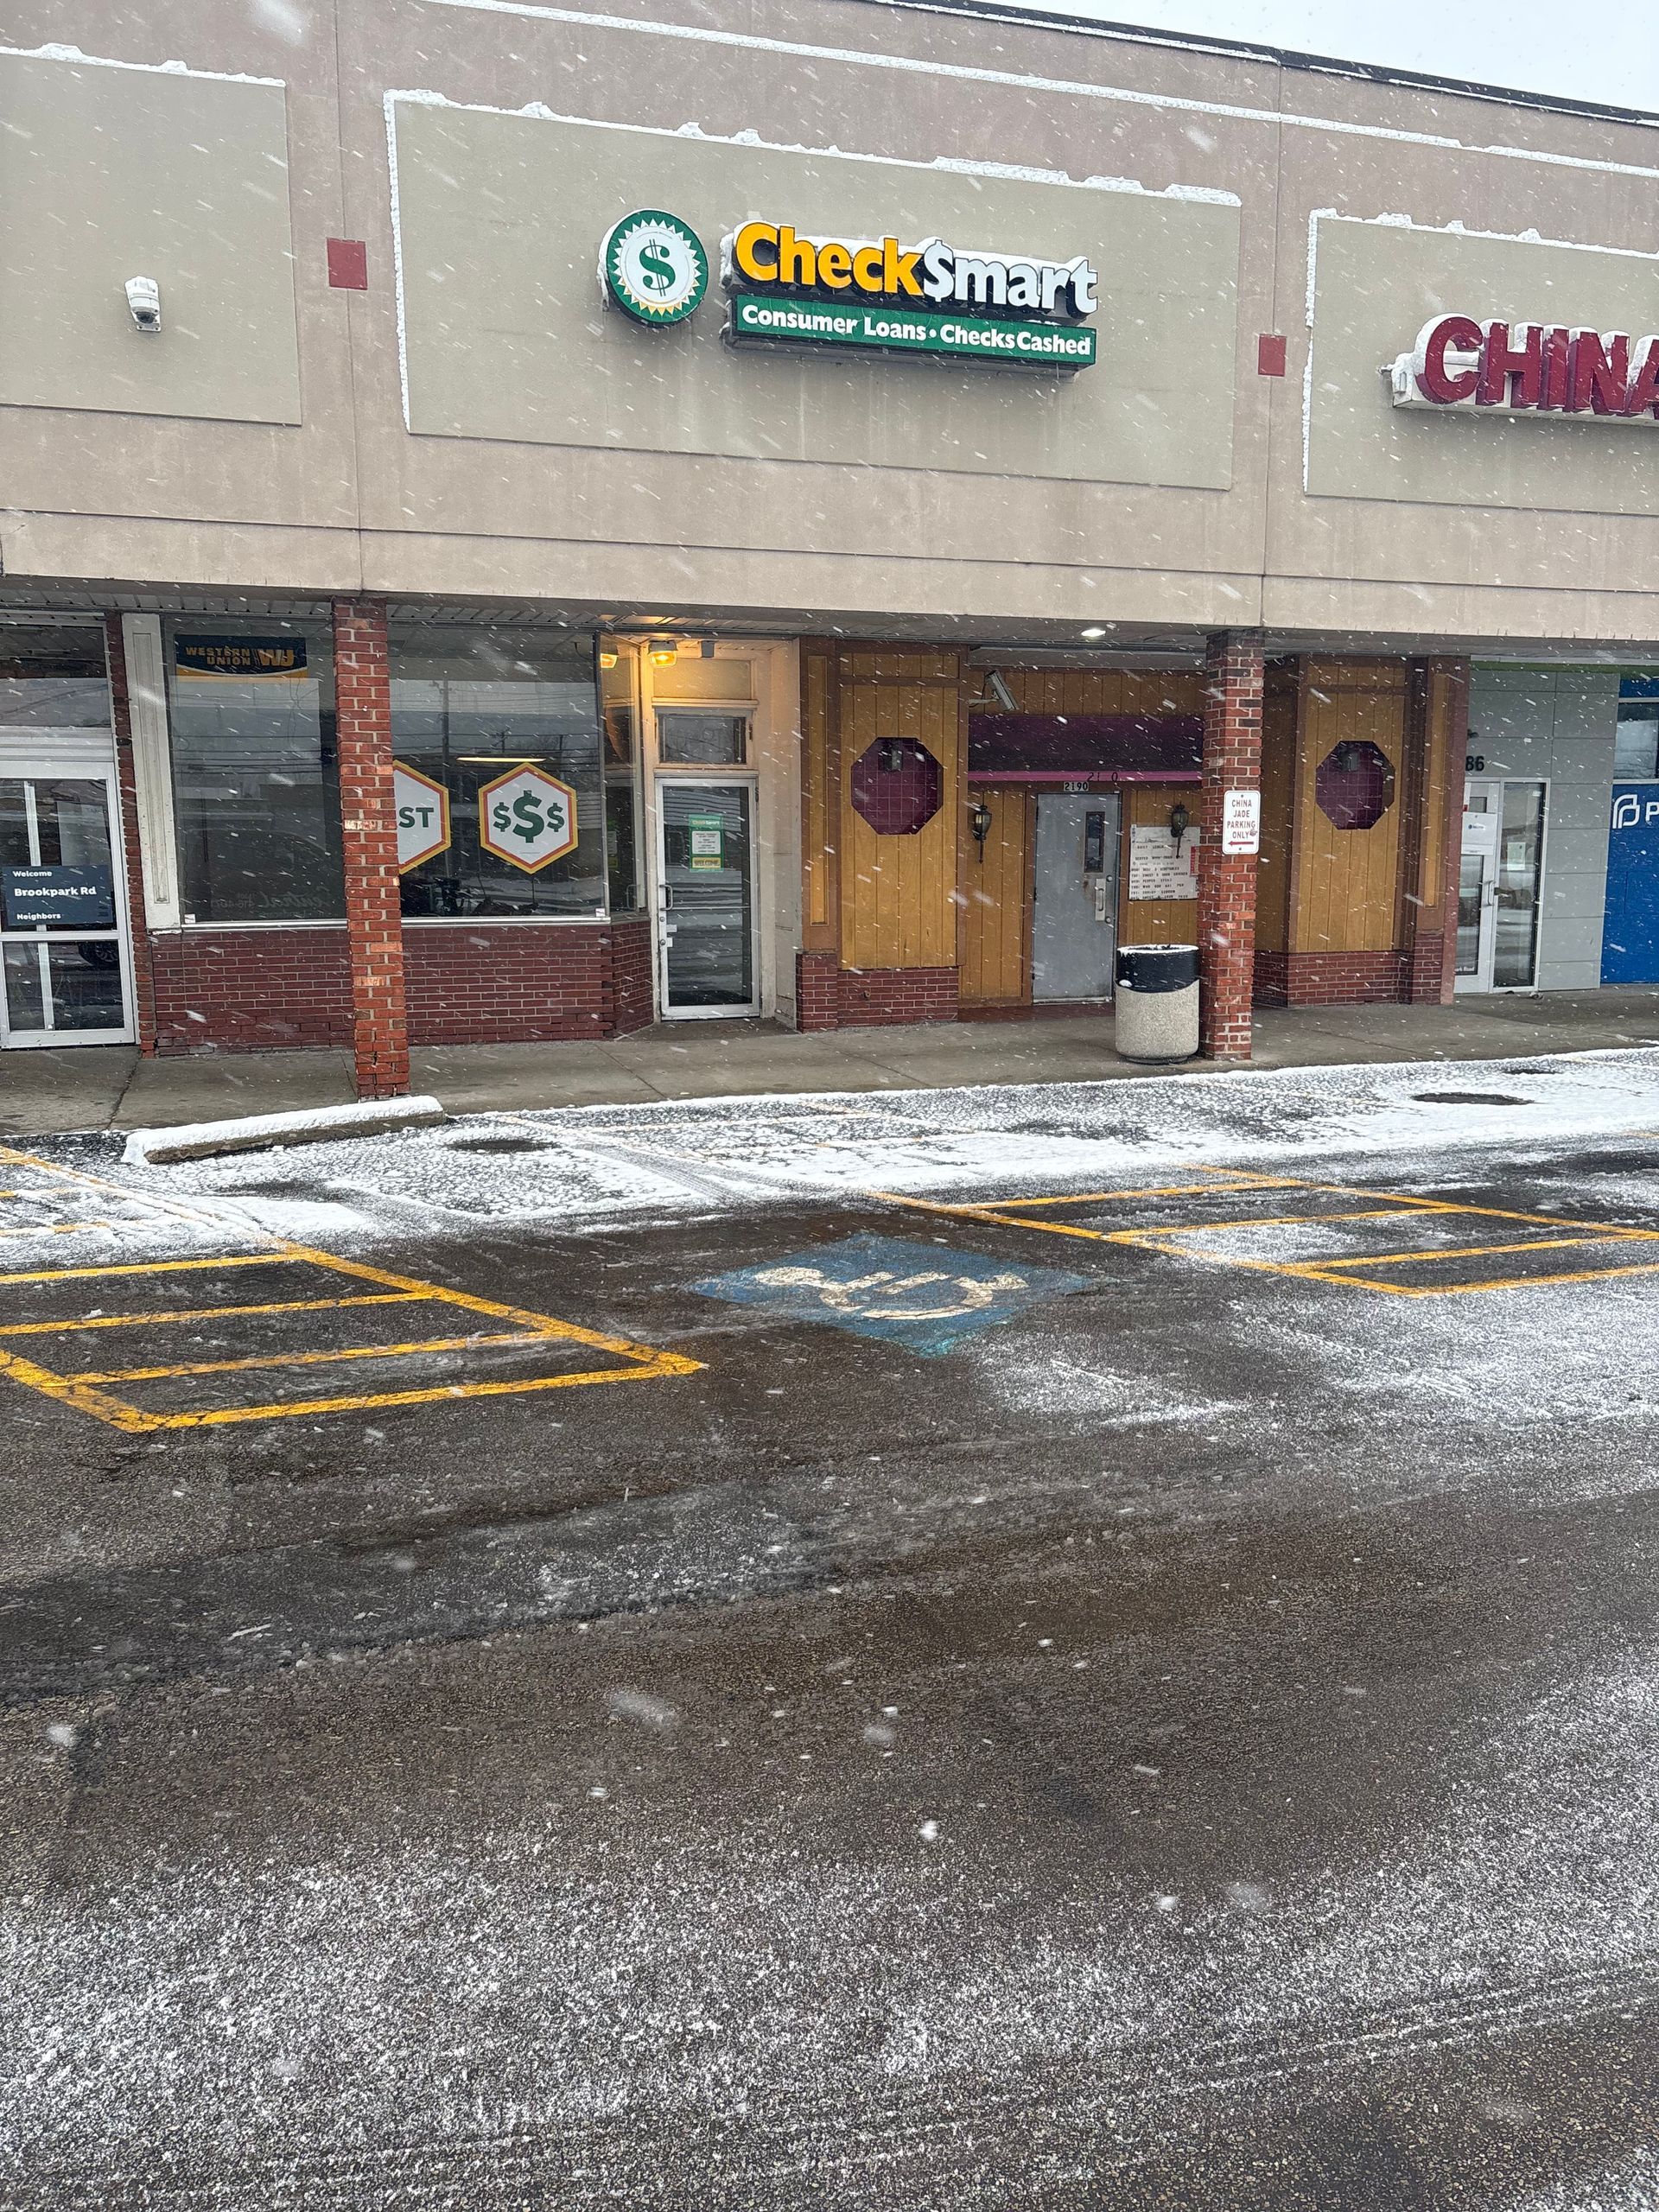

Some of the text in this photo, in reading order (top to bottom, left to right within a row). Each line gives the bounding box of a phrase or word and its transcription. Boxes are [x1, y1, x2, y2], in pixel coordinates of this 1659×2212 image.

[742, 304, 1090, 355] Consumer Loans Checks Cashed
[185, 646, 251, 657] WESTERN
[207, 657, 251, 665] UNION
[1065, 782, 1088, 791] 2190
[1231, 799, 1252, 808] CHINA
[398, 807, 434, 828] ST
[1226, 820, 1255, 829] PARKING
[14, 887, 97, 897] Brookpark Rd
[16, 912, 61, 921] Neighbors
